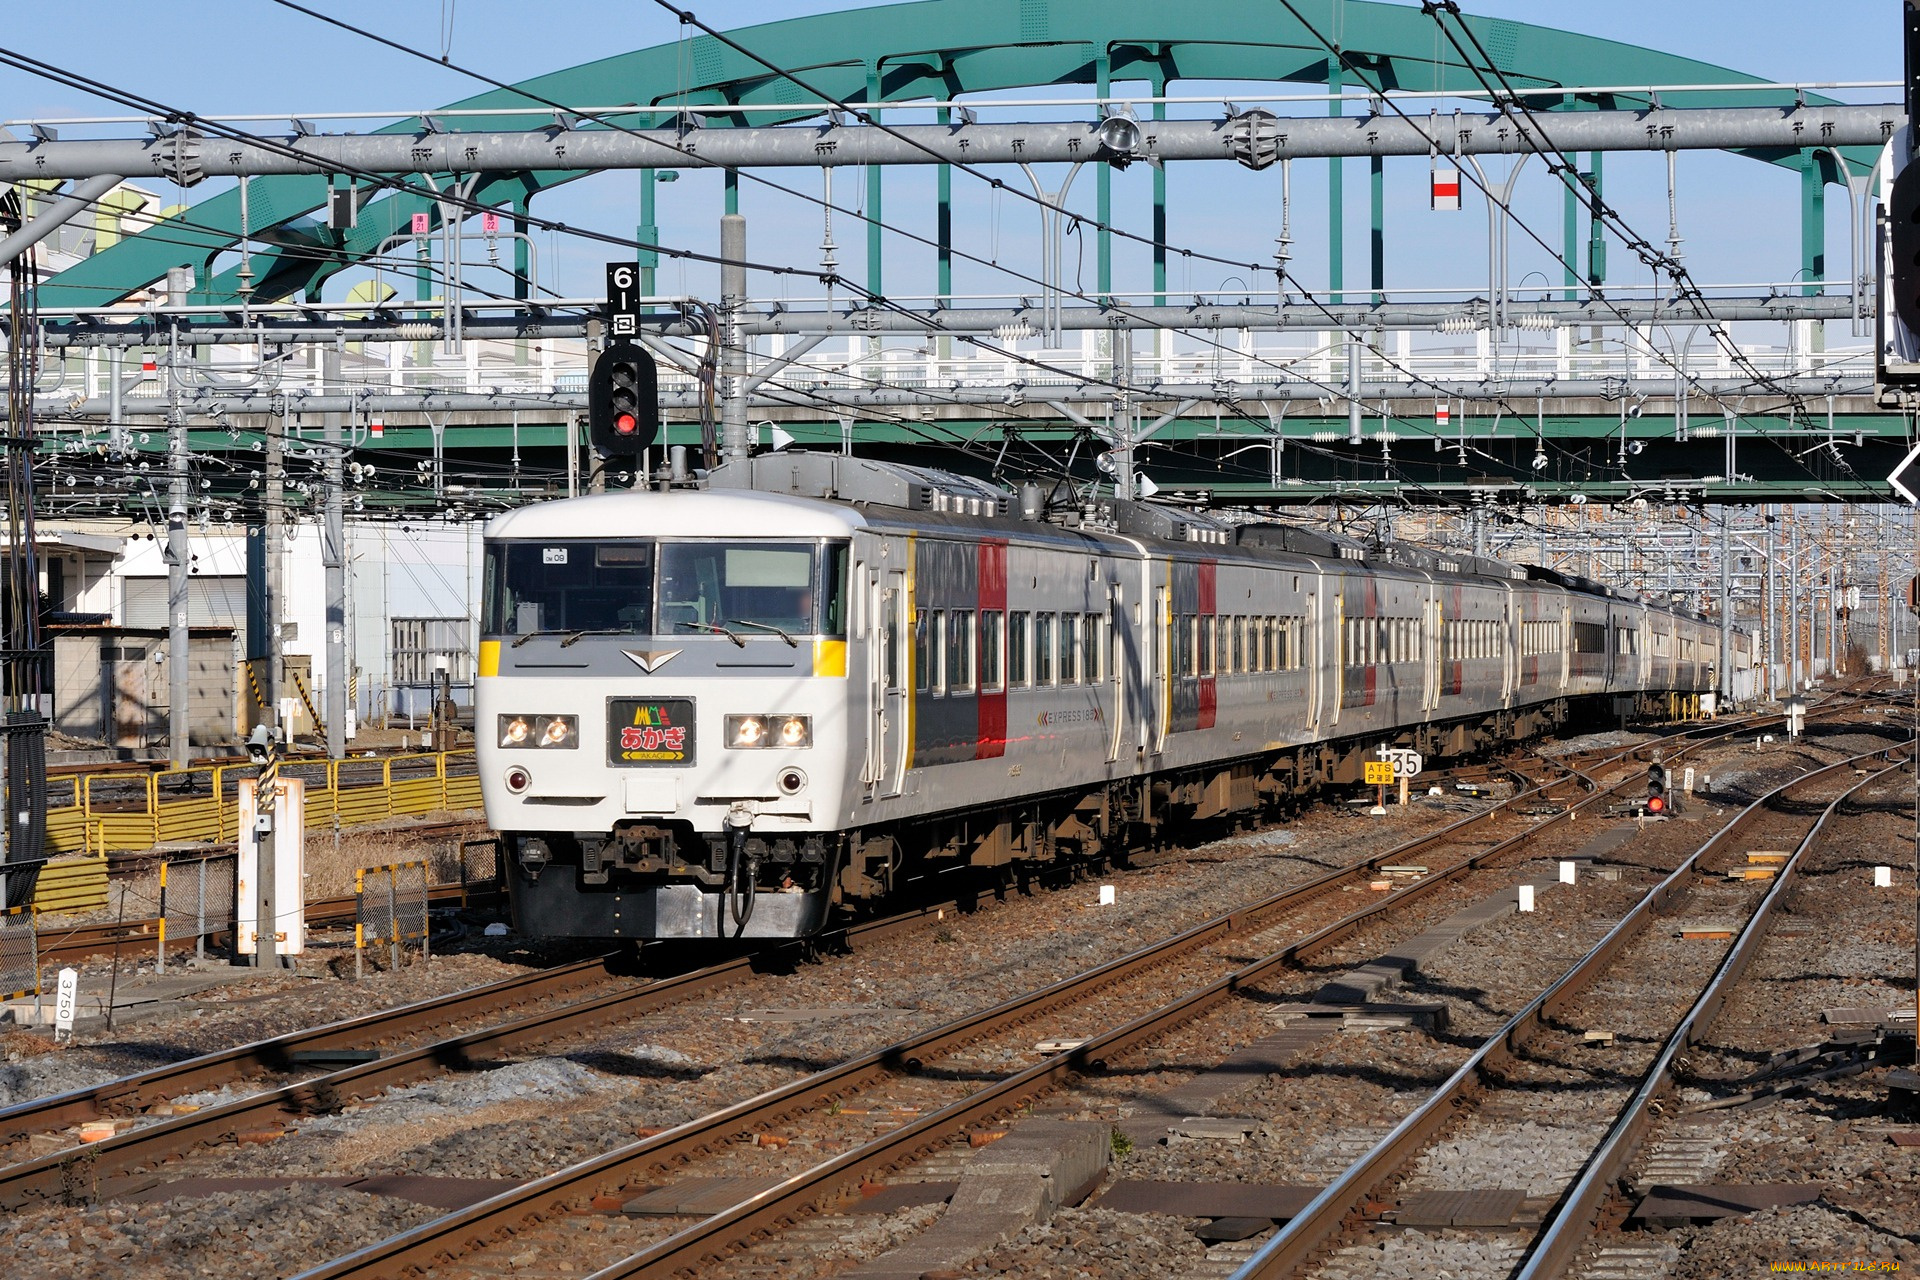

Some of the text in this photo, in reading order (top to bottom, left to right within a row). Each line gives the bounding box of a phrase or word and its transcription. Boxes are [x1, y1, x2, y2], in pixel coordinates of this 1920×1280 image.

[620, 727, 686, 750] あかぎ
[1368, 764, 1391, 772] ATS
[1392, 753, 1417, 774] 35
[60, 980, 72, 1018] 3750
